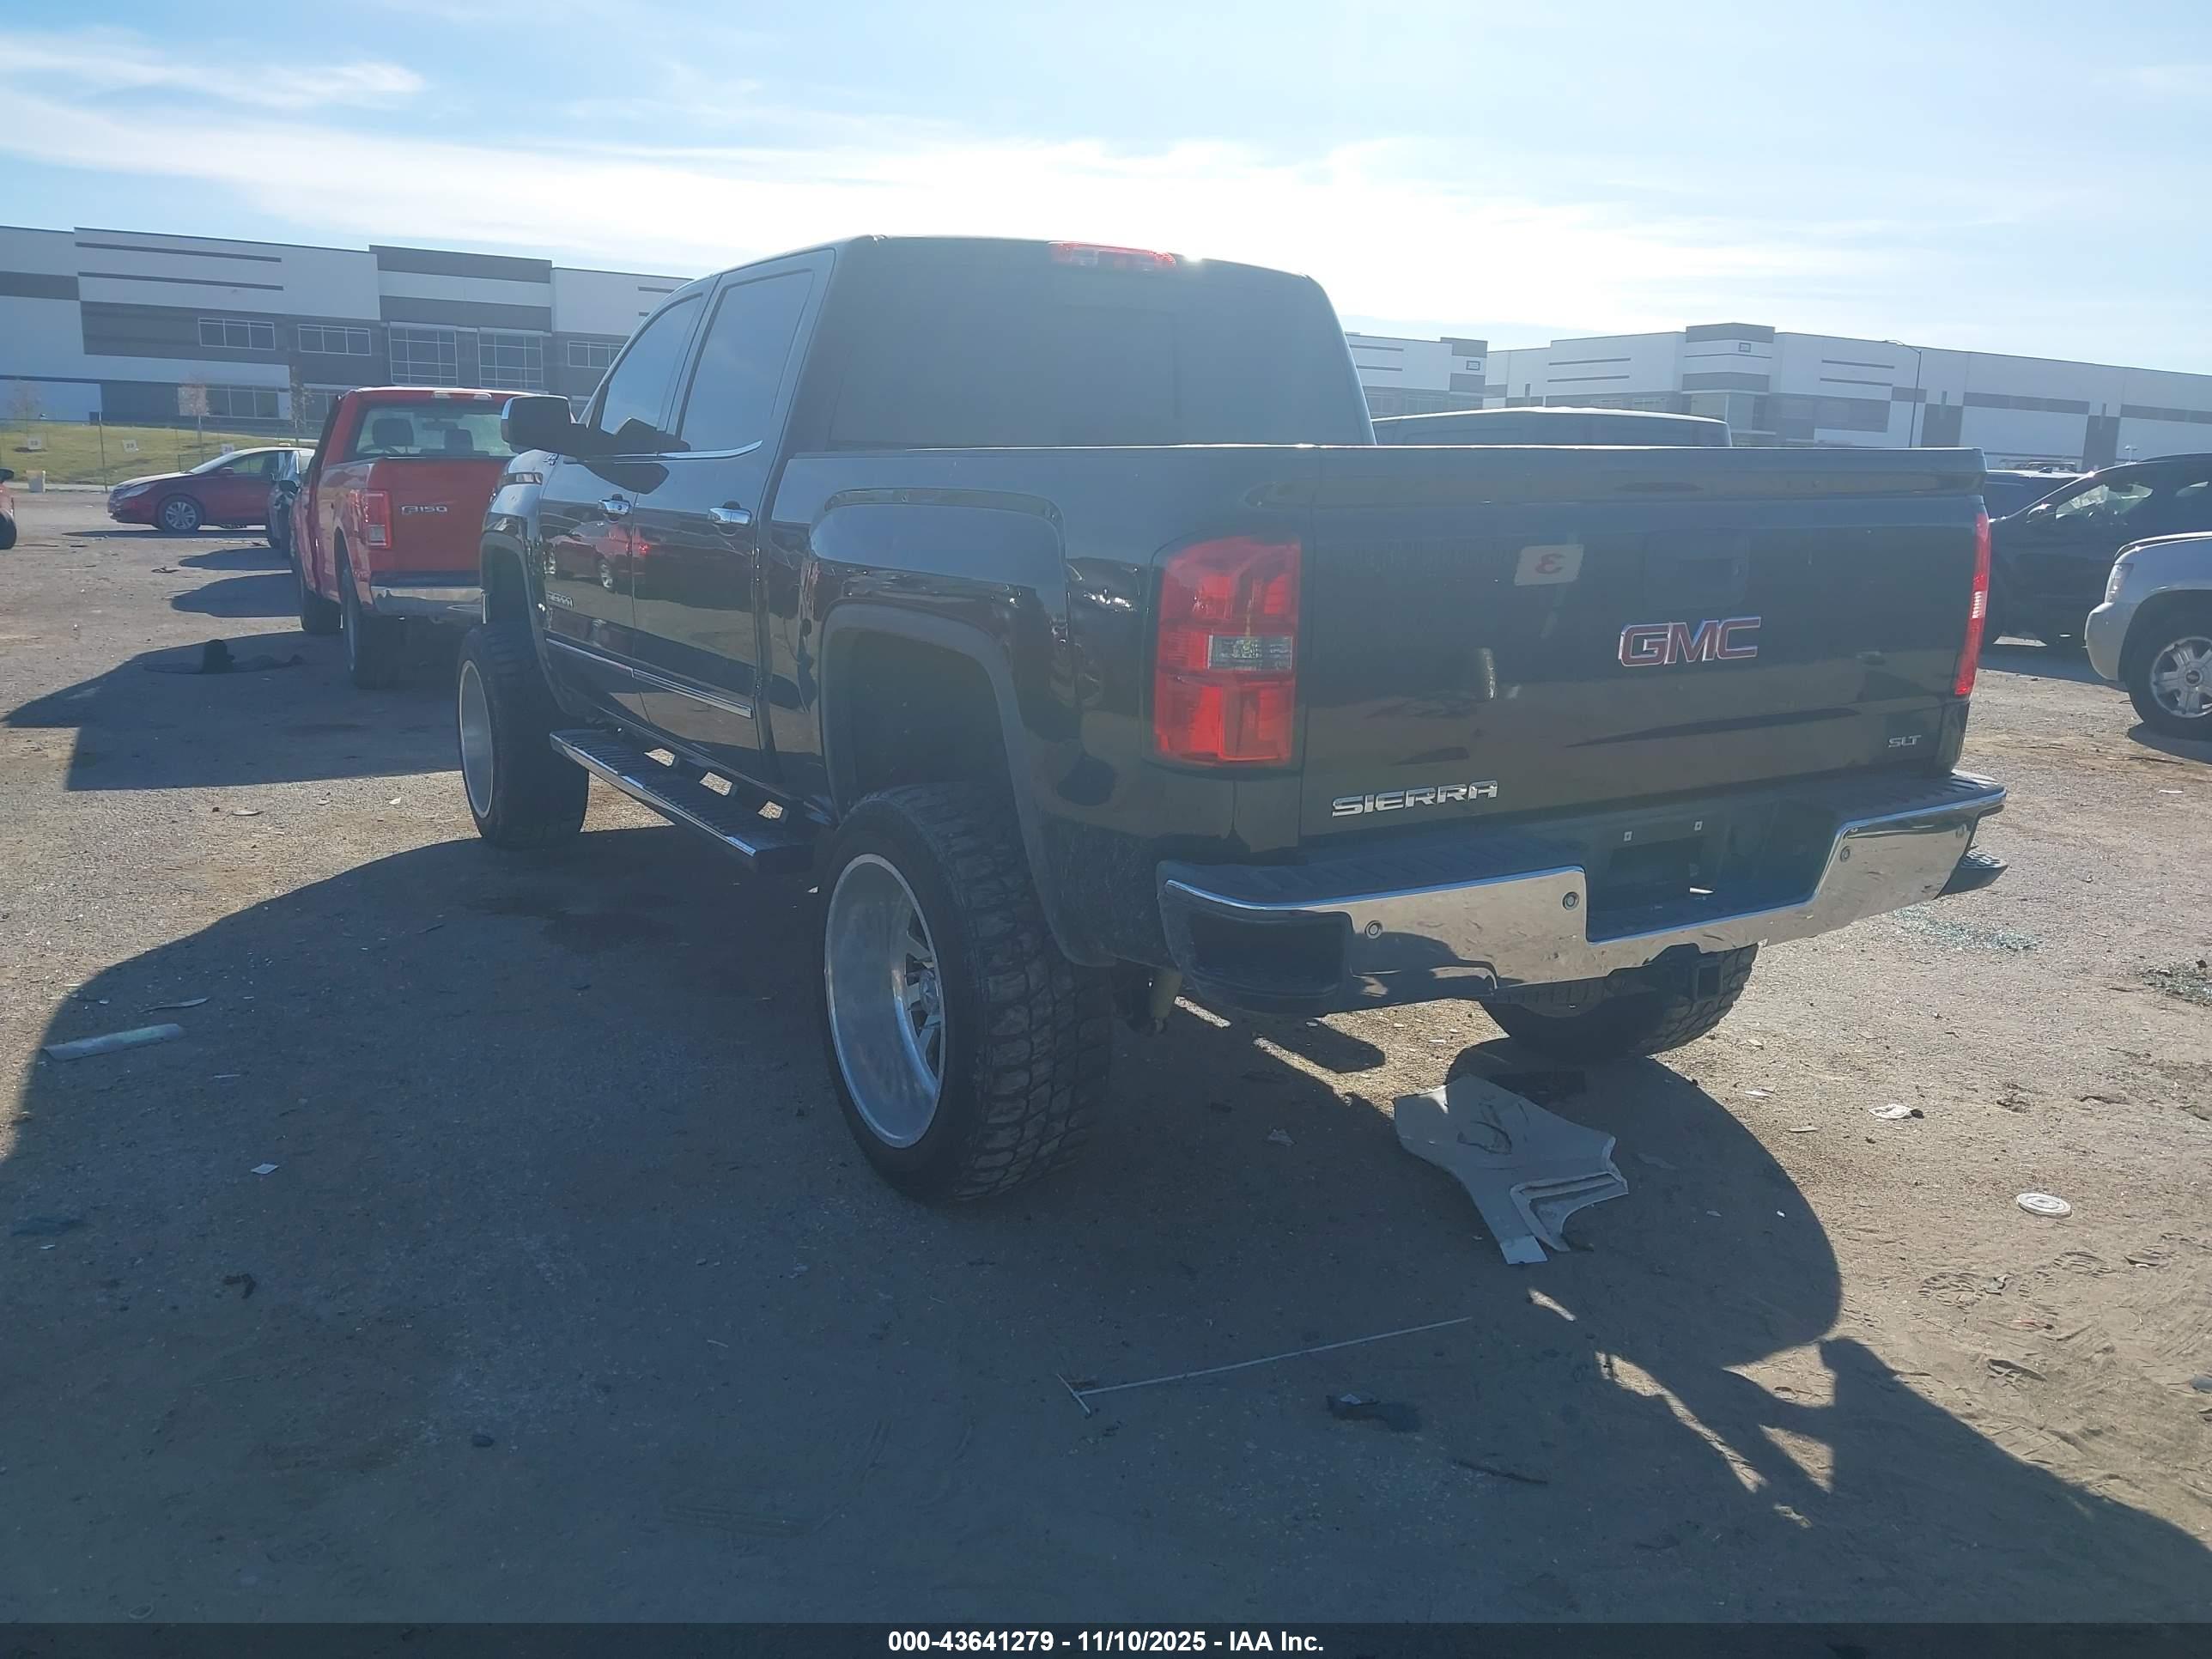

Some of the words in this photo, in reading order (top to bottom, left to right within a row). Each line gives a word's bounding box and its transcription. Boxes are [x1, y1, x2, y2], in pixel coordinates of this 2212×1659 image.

[1619, 617, 1761, 666] GMC
[1888, 734, 1922, 747] SLT
[1332, 780, 1498, 817] SIERRA
